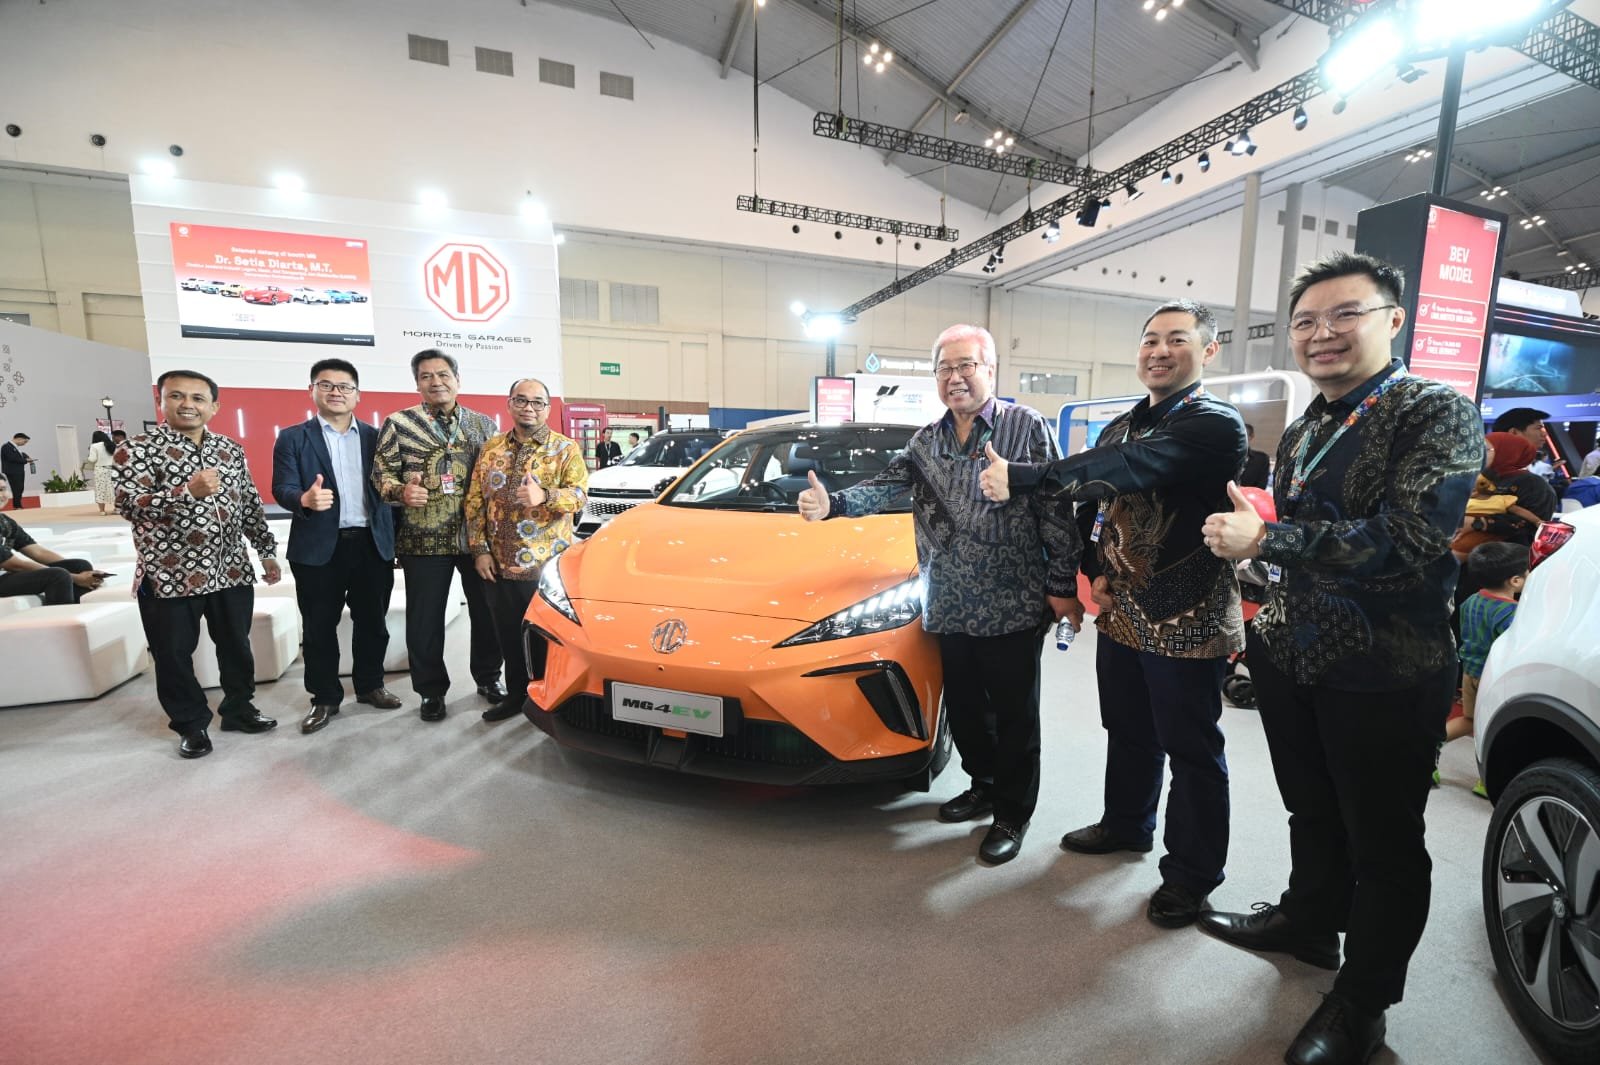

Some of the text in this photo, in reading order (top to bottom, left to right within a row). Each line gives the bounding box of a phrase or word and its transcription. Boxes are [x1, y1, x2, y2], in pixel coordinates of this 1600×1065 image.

[214, 254, 232, 265] Dr.
[234, 256, 266, 268] Setia
[268, 258, 308, 272] Diarta,
[310, 262, 333, 273] M.T.
[1448, 245, 1470, 264] BEV
[432, 251, 500, 314] MG
[1439, 263, 1473, 284] MODEL
[403, 330, 532, 343] MORRIS GARAGES
[436, 340, 504, 350] Driven by Passion
[1427, 336, 1433, 345] 5
[653, 620, 684, 651] MG
